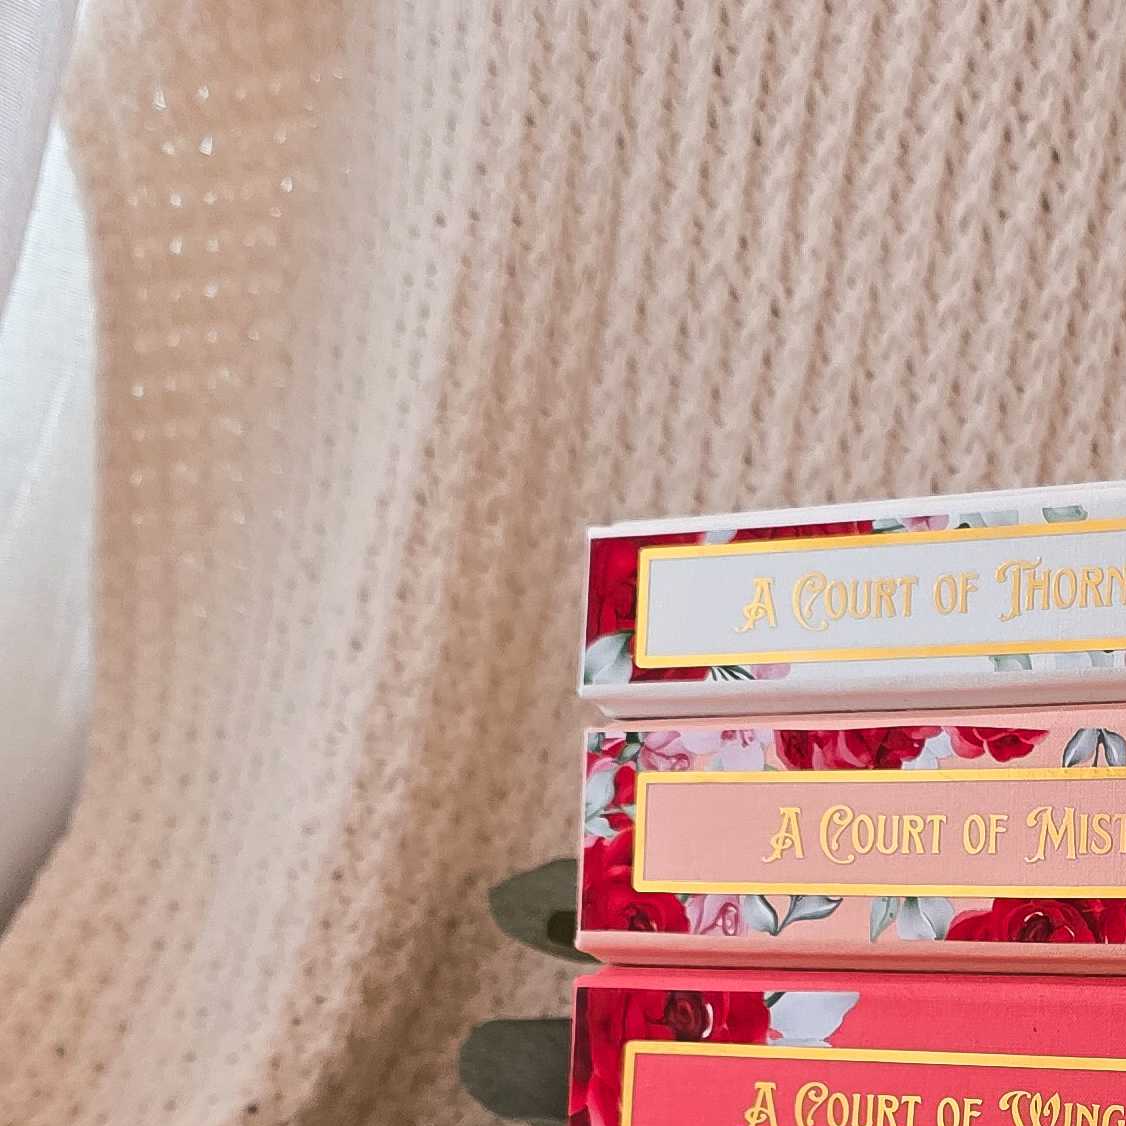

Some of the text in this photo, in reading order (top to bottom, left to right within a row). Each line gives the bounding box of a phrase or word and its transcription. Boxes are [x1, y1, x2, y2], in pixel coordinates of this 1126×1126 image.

[739, 577, 777, 633] A
[792, 571, 919, 630] COURT
[934, 574, 979, 614] OF
[764, 806, 804, 863] A
[820, 805, 947, 864] COURT
[962, 814, 1009, 855] OF
